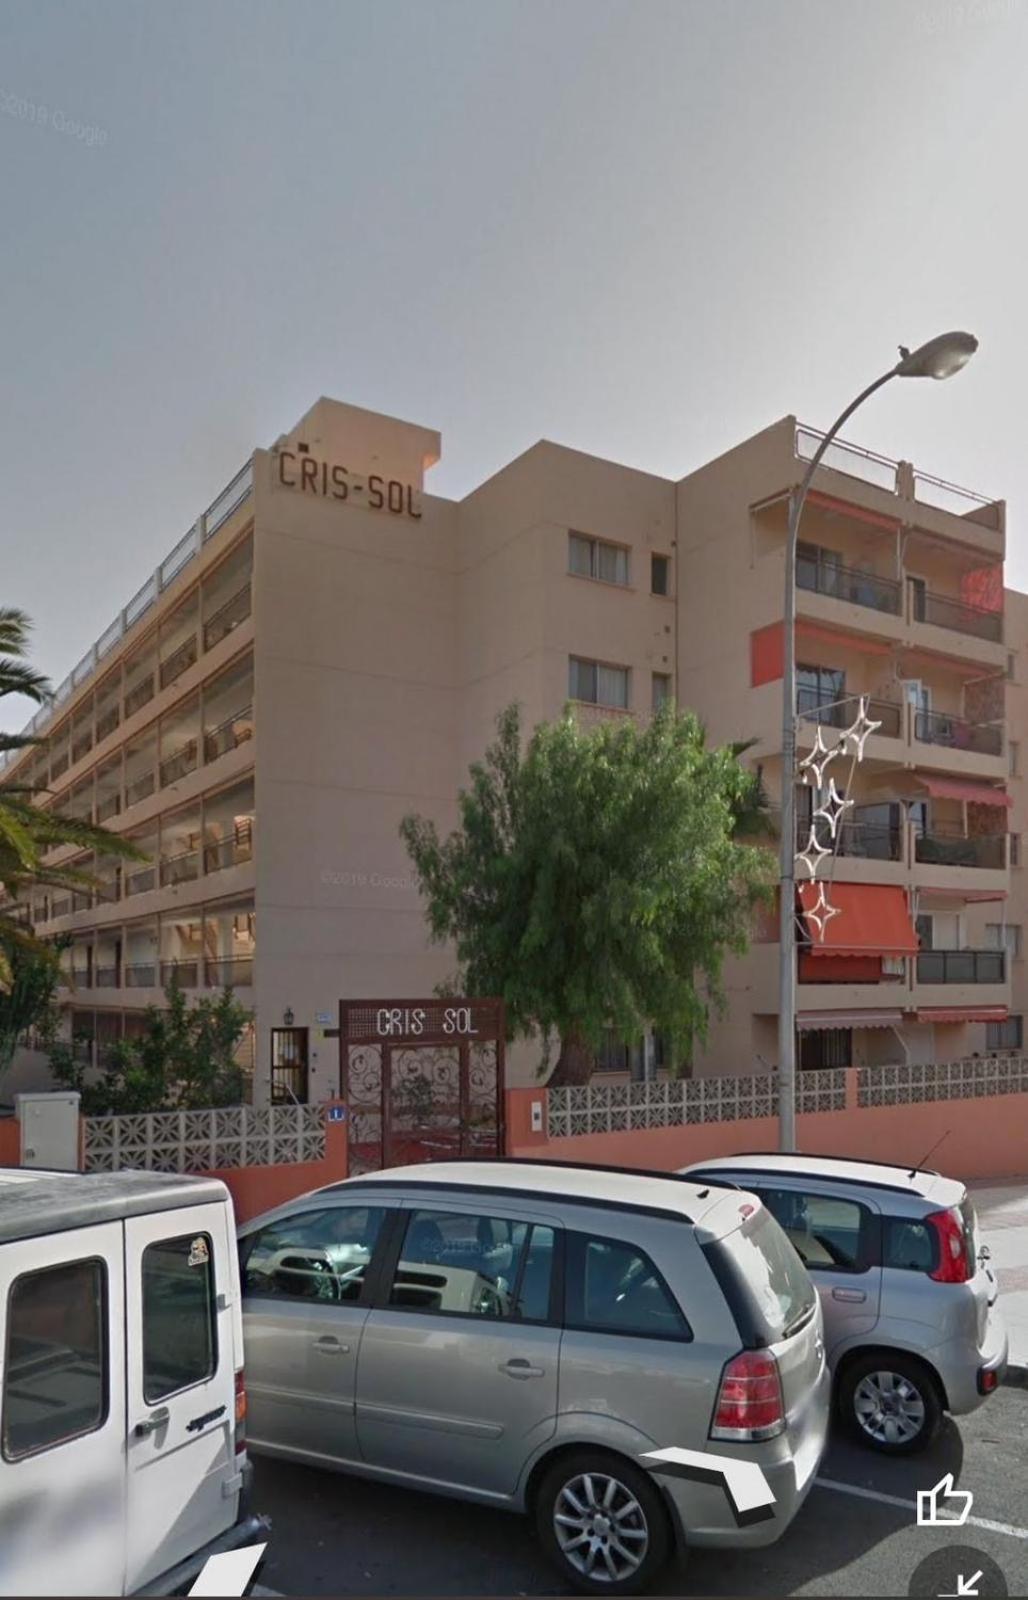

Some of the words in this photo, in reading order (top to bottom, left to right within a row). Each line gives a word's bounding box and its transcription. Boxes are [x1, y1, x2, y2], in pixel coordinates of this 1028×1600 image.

[279, 452, 422, 518] CRIS-SOL
[377, 1007, 426, 1036] CRIS
[442, 1007, 479, 1034] SOL
